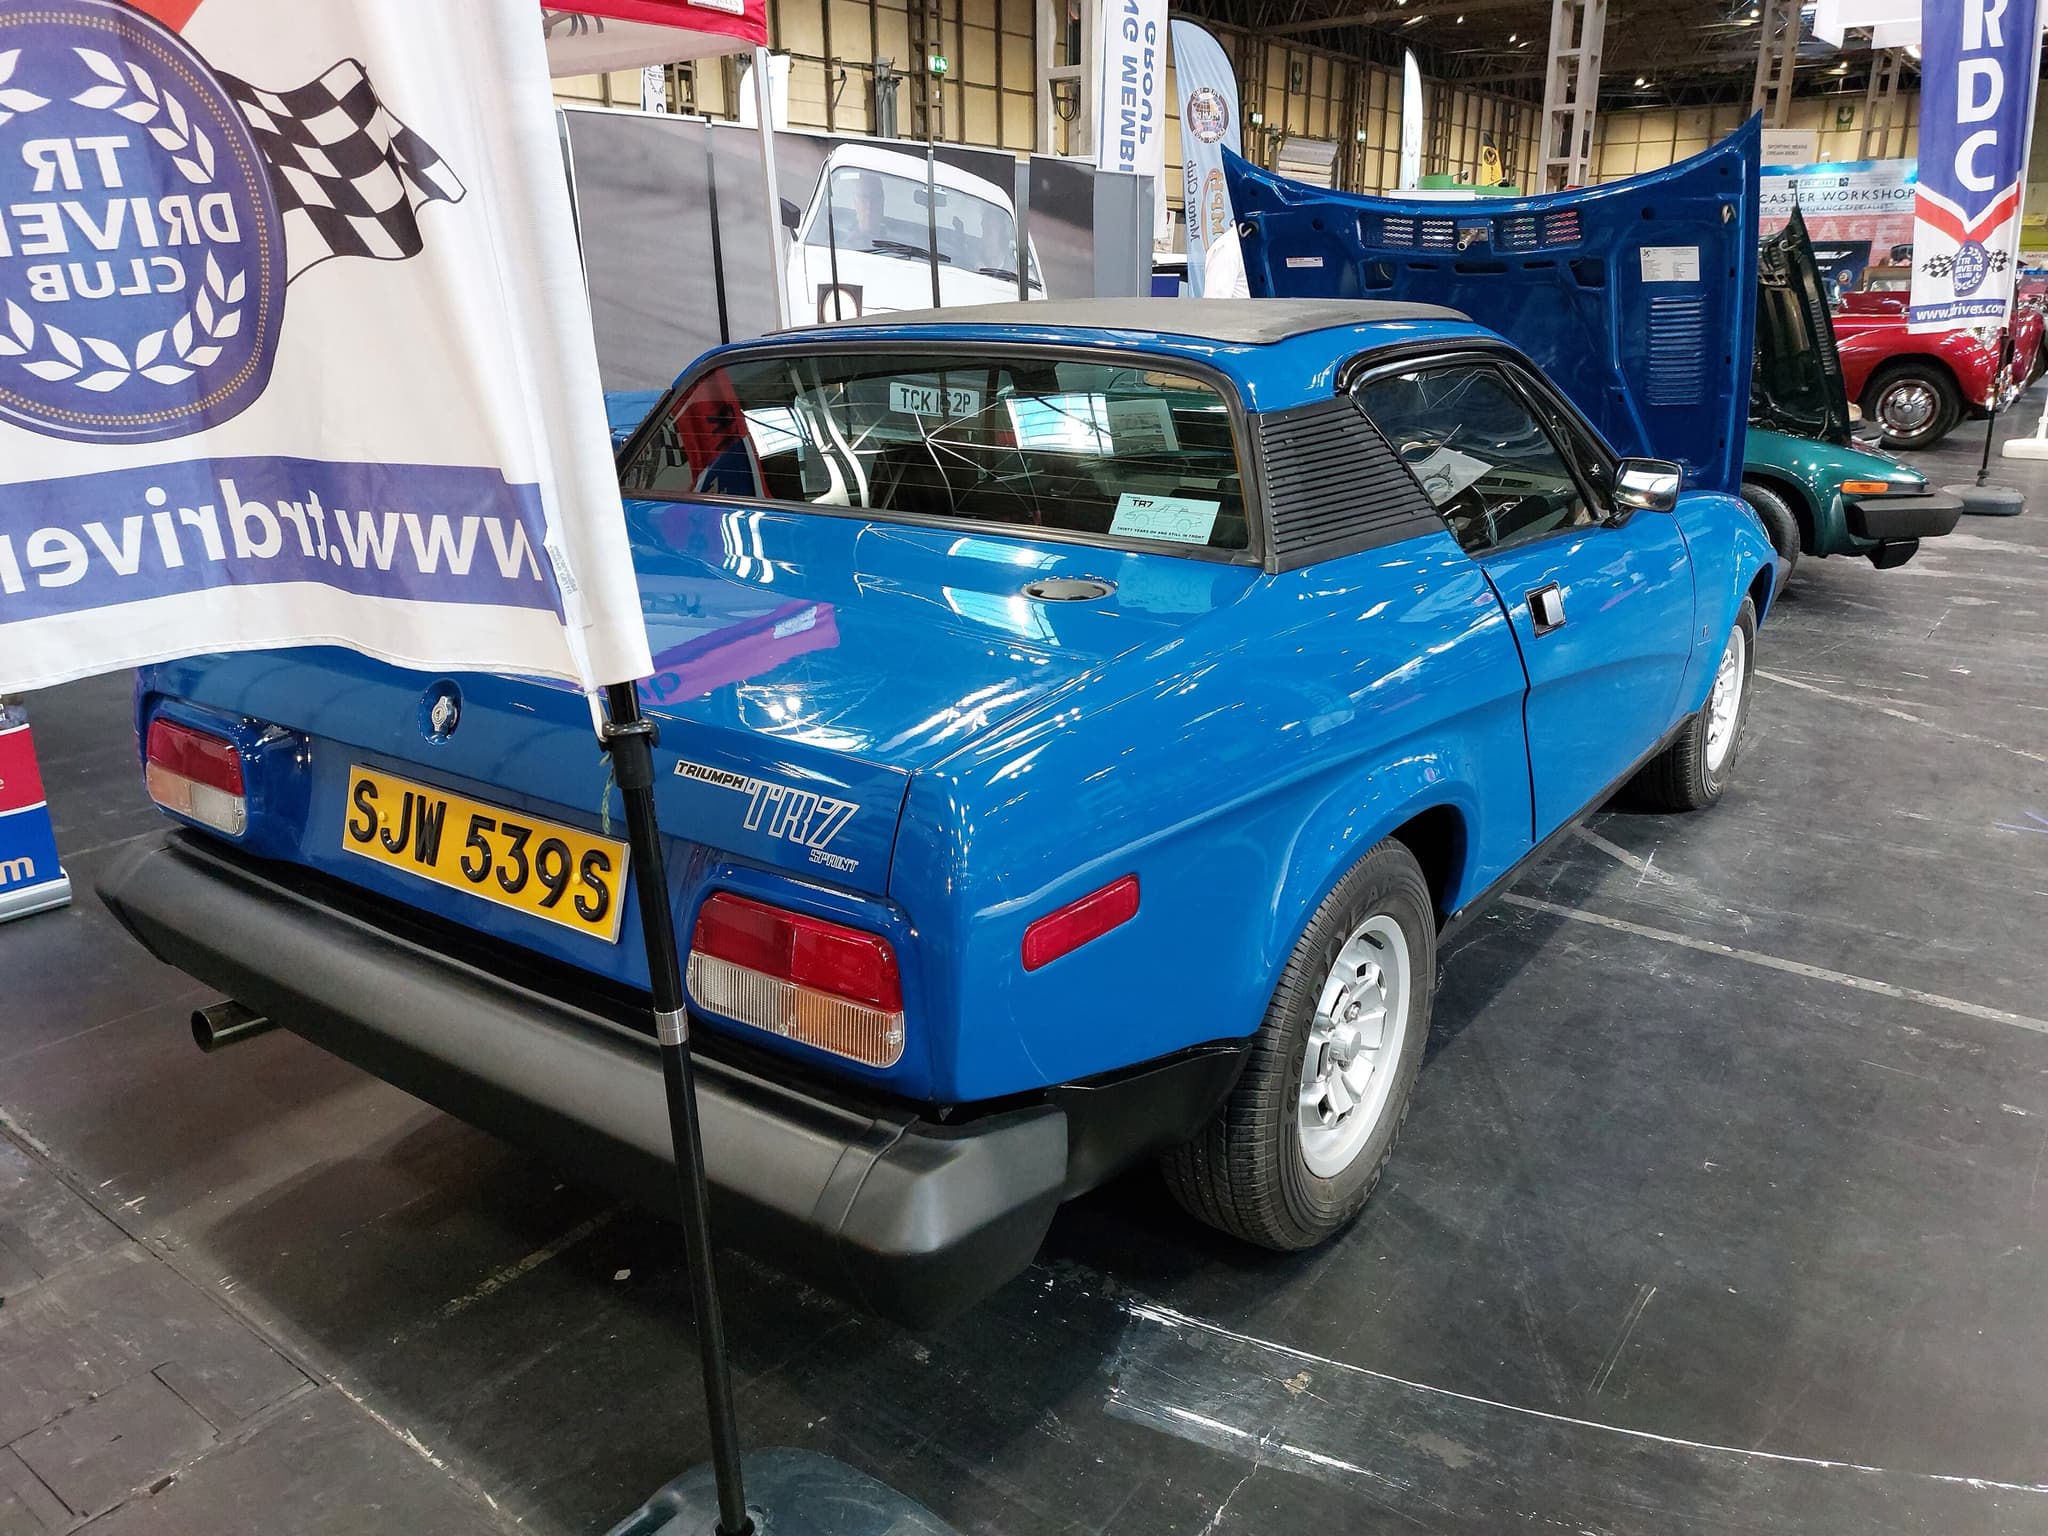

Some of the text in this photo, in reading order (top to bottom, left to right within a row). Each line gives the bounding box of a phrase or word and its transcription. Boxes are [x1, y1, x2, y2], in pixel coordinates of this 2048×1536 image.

[1760, 192, 1815, 204] CASTER
[900, 388, 931, 412] TCK
[1132, 499, 1154, 508] TR7
[676, 760, 861, 849] TRIUMPH TR7
[349, 779, 612, 923] SJW 539S
[808, 849, 859, 873] SPRINT
